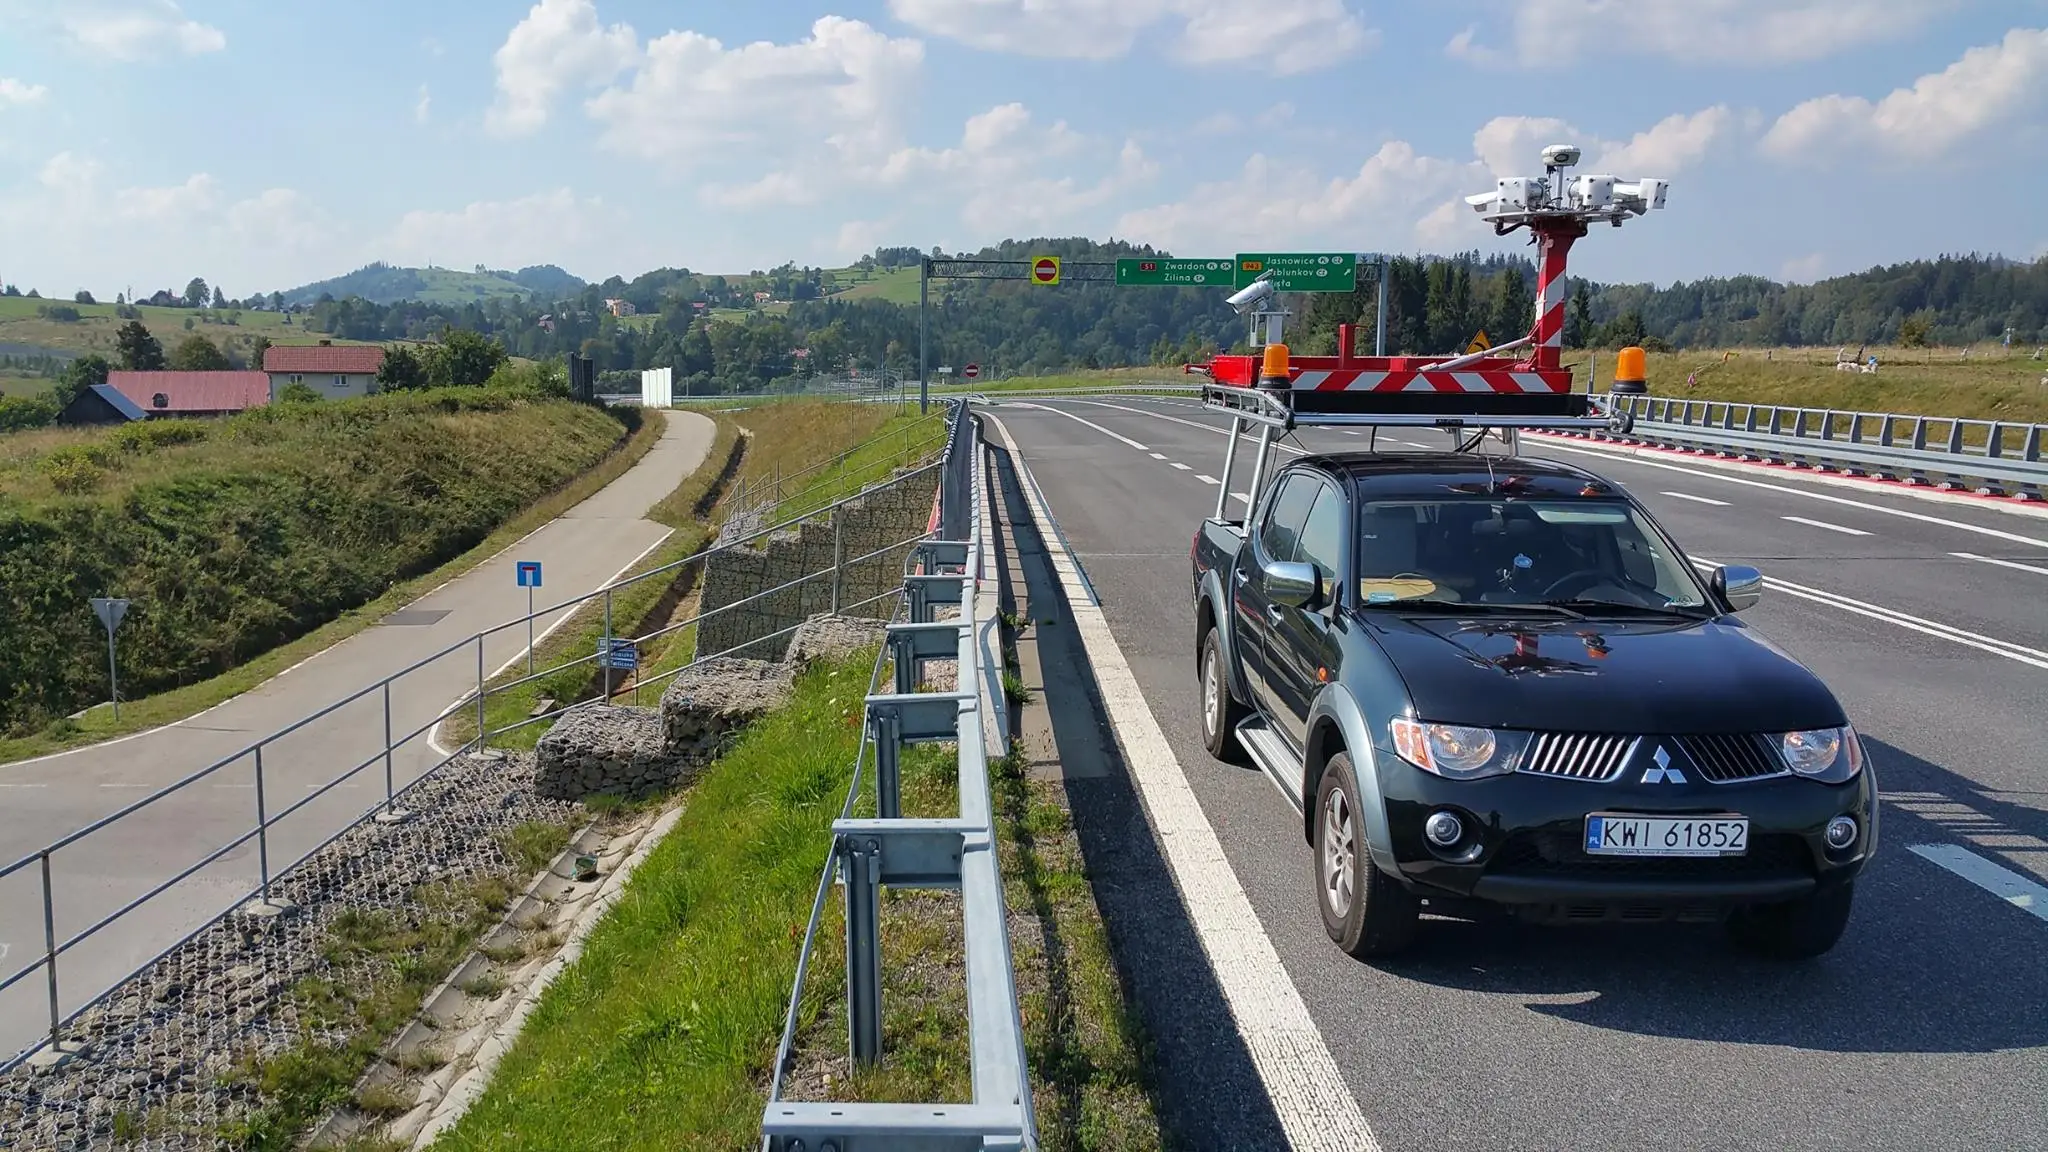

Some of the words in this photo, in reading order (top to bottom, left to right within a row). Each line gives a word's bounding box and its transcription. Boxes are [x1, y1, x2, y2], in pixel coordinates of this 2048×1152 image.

[1266, 256, 1315, 265] Jasnowice
[1603, 821, 1649, 847] KWI
[1664, 822, 1744, 848] 61852
[1589, 837, 1599, 845] PL
